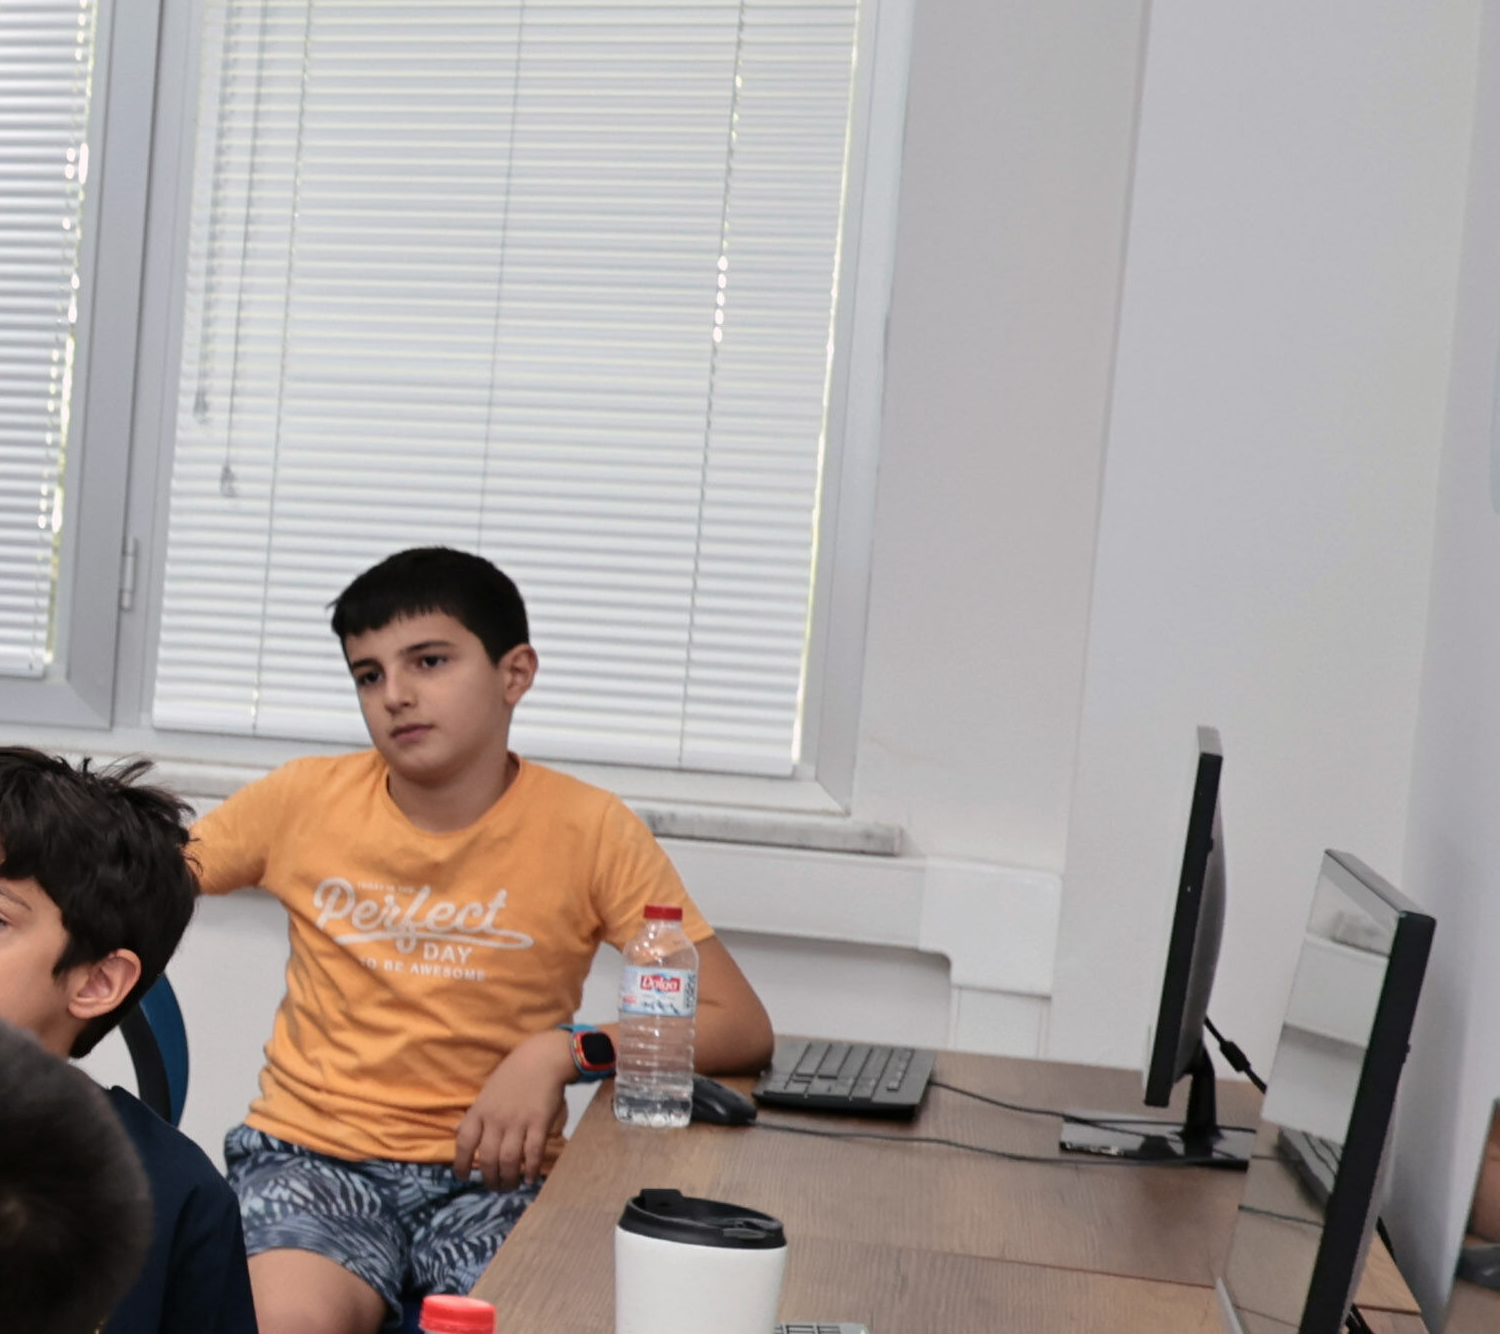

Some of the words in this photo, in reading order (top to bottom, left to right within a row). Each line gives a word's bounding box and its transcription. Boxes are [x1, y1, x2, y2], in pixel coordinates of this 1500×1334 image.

[312, 876, 514, 954] Perfect
[422, 942, 473, 965] DAY
[383, 959, 405, 972] BE
[409, 962, 487, 982] AWESOME
